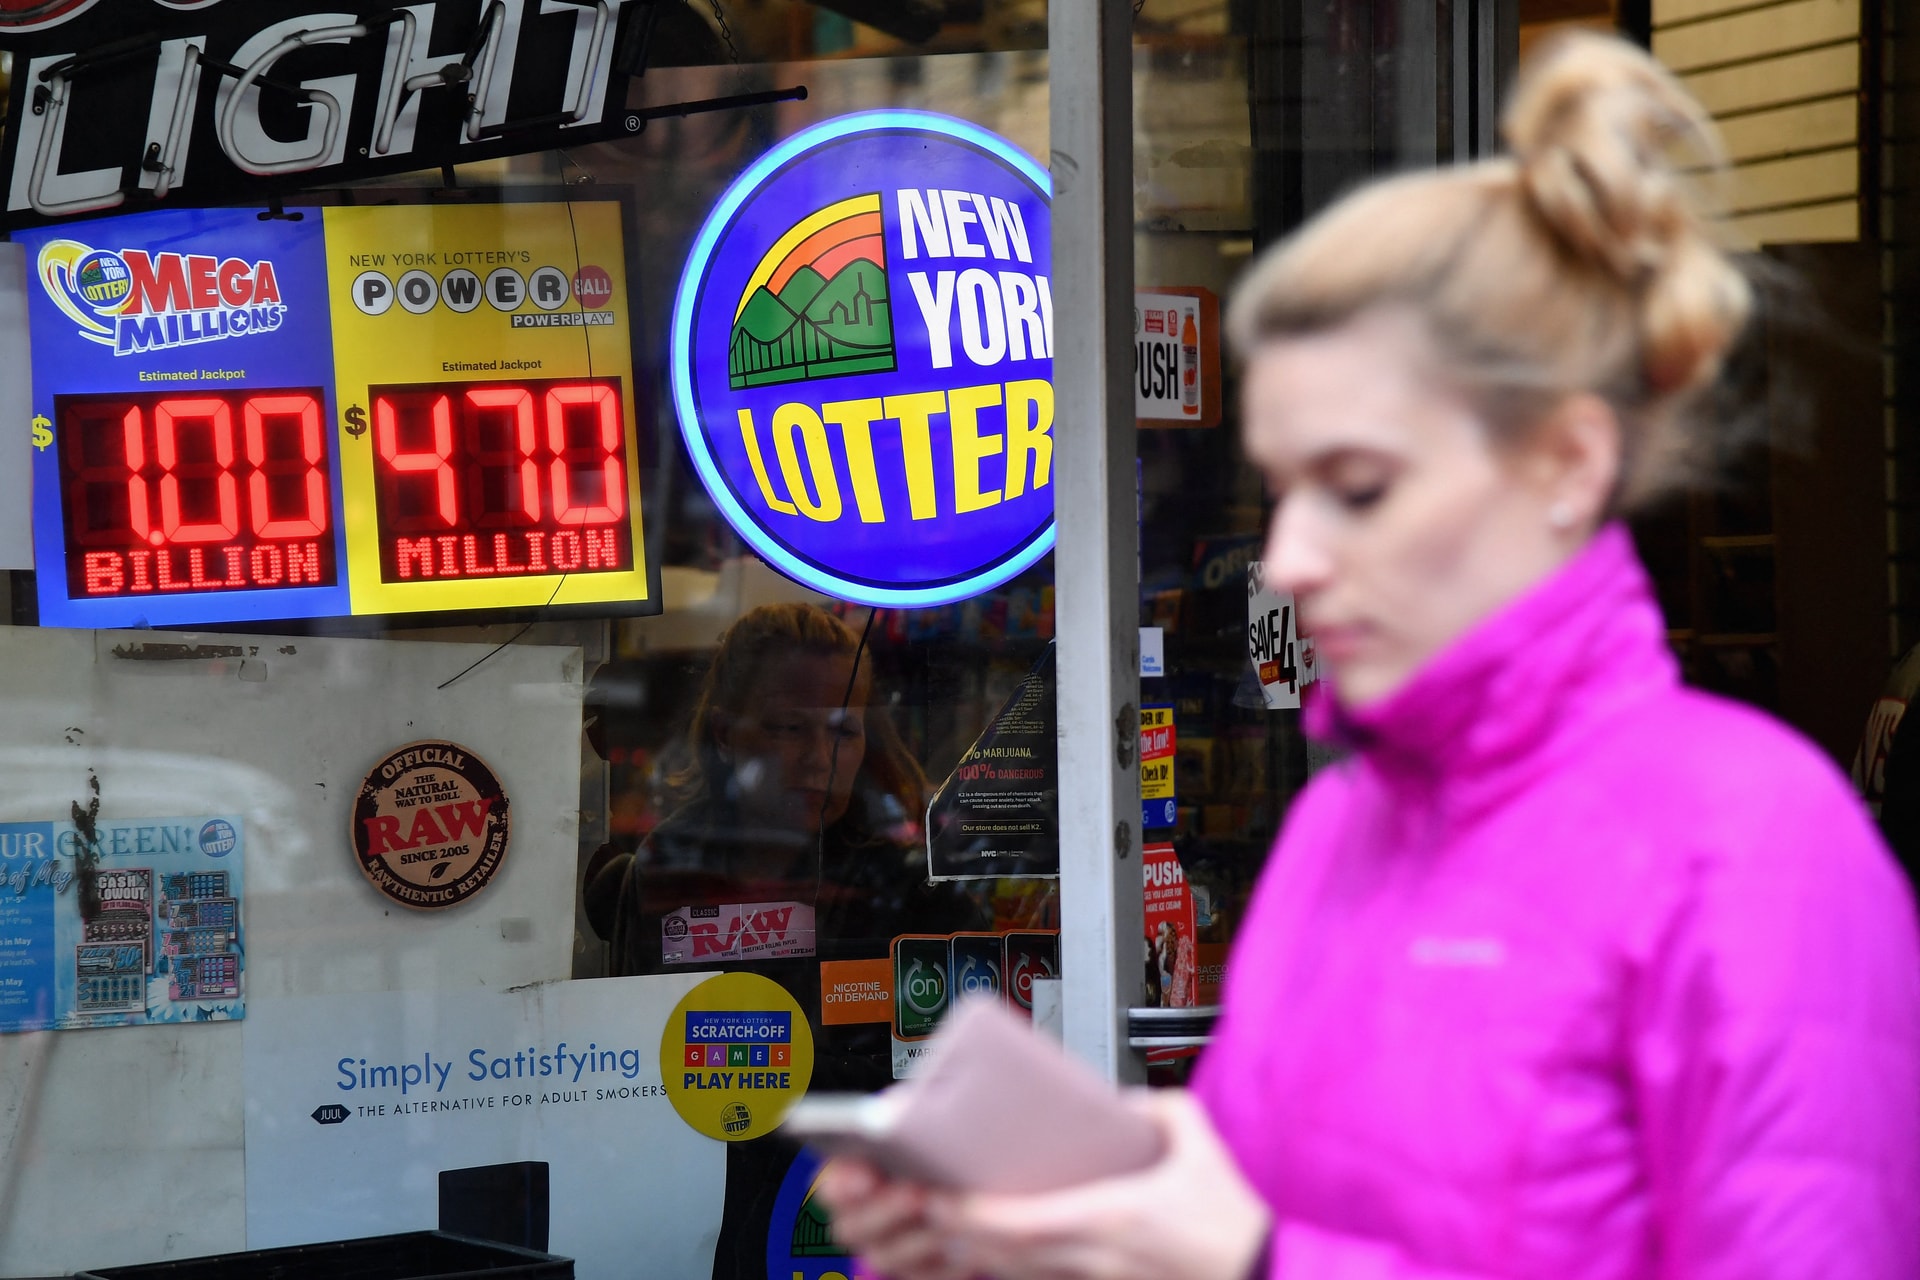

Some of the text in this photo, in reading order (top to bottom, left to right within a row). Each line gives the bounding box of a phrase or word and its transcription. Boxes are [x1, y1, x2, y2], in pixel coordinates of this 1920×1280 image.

[7, 0, 625, 213] LIGHT
[897, 188, 1033, 264] NEW
[99, 257, 119, 268] NEW
[350, 251, 531, 267] NEW YORK LOTTERY'S
[102, 268, 126, 280] YORK
[119, 249, 281, 316] MEGA
[83, 279, 130, 301] LOTTERY
[358, 270, 566, 310] POWER
[116, 307, 283, 355] MILLIONS
[442, 359, 542, 372] Estimated Jackpot
[1134, 341, 1179, 400] USH
[138, 368, 246, 382] Estimated Jackpot
[376, 385, 624, 527] 470
[736, 379, 1055, 523] LOTTER
[397, 528, 617, 577] MILLION
[85, 542, 320, 593] BILLION
[1250, 605, 1297, 694] SAVE 4
[983, 747, 1032, 759] MARIJUANA
[381, 749, 465, 780] OFFICIAL
[958, 763, 1044, 781] 100% DANGEROUS
[1142, 765, 1158, 781] Check
[414, 774, 436, 784] THE
[394, 780, 459, 800] NATURAL
[394, 791, 460, 808] WAY TO ROLL
[363, 794, 500, 857] RAW
[400, 845, 470, 865] SINCE 2005
[368, 831, 504, 903] RAWTHENTIC RETAILER
[1142, 860, 1184, 887] PUSH
[31, 859, 73, 894] May
[98, 875, 137, 888] CASH
[97, 887, 146, 900] LOWOUT
[692, 908, 719, 917] CLASSIC
[689, 906, 794, 957] RAW
[765, 942, 781, 950] ROLLING
[833, 982, 880, 993] NICOTINE
[911, 978, 942, 996] on!
[1206, 974, 1227, 984] FRE
[845, 991, 889, 1002] DEMAND
[692, 1025, 785, 1038] SCRATCH-OFF
[689, 1050, 786, 1063] GAMES
[337, 1043, 640, 1095] Simply Satisfying
[683, 1072, 790, 1089] PLAY HERE
[358, 1084, 667, 1118] THE ALTERNATIVE FOR ADULT SMOKERS
[320, 1108, 342, 1120] JUUL
[724, 1119, 751, 1132] LOTTERY
